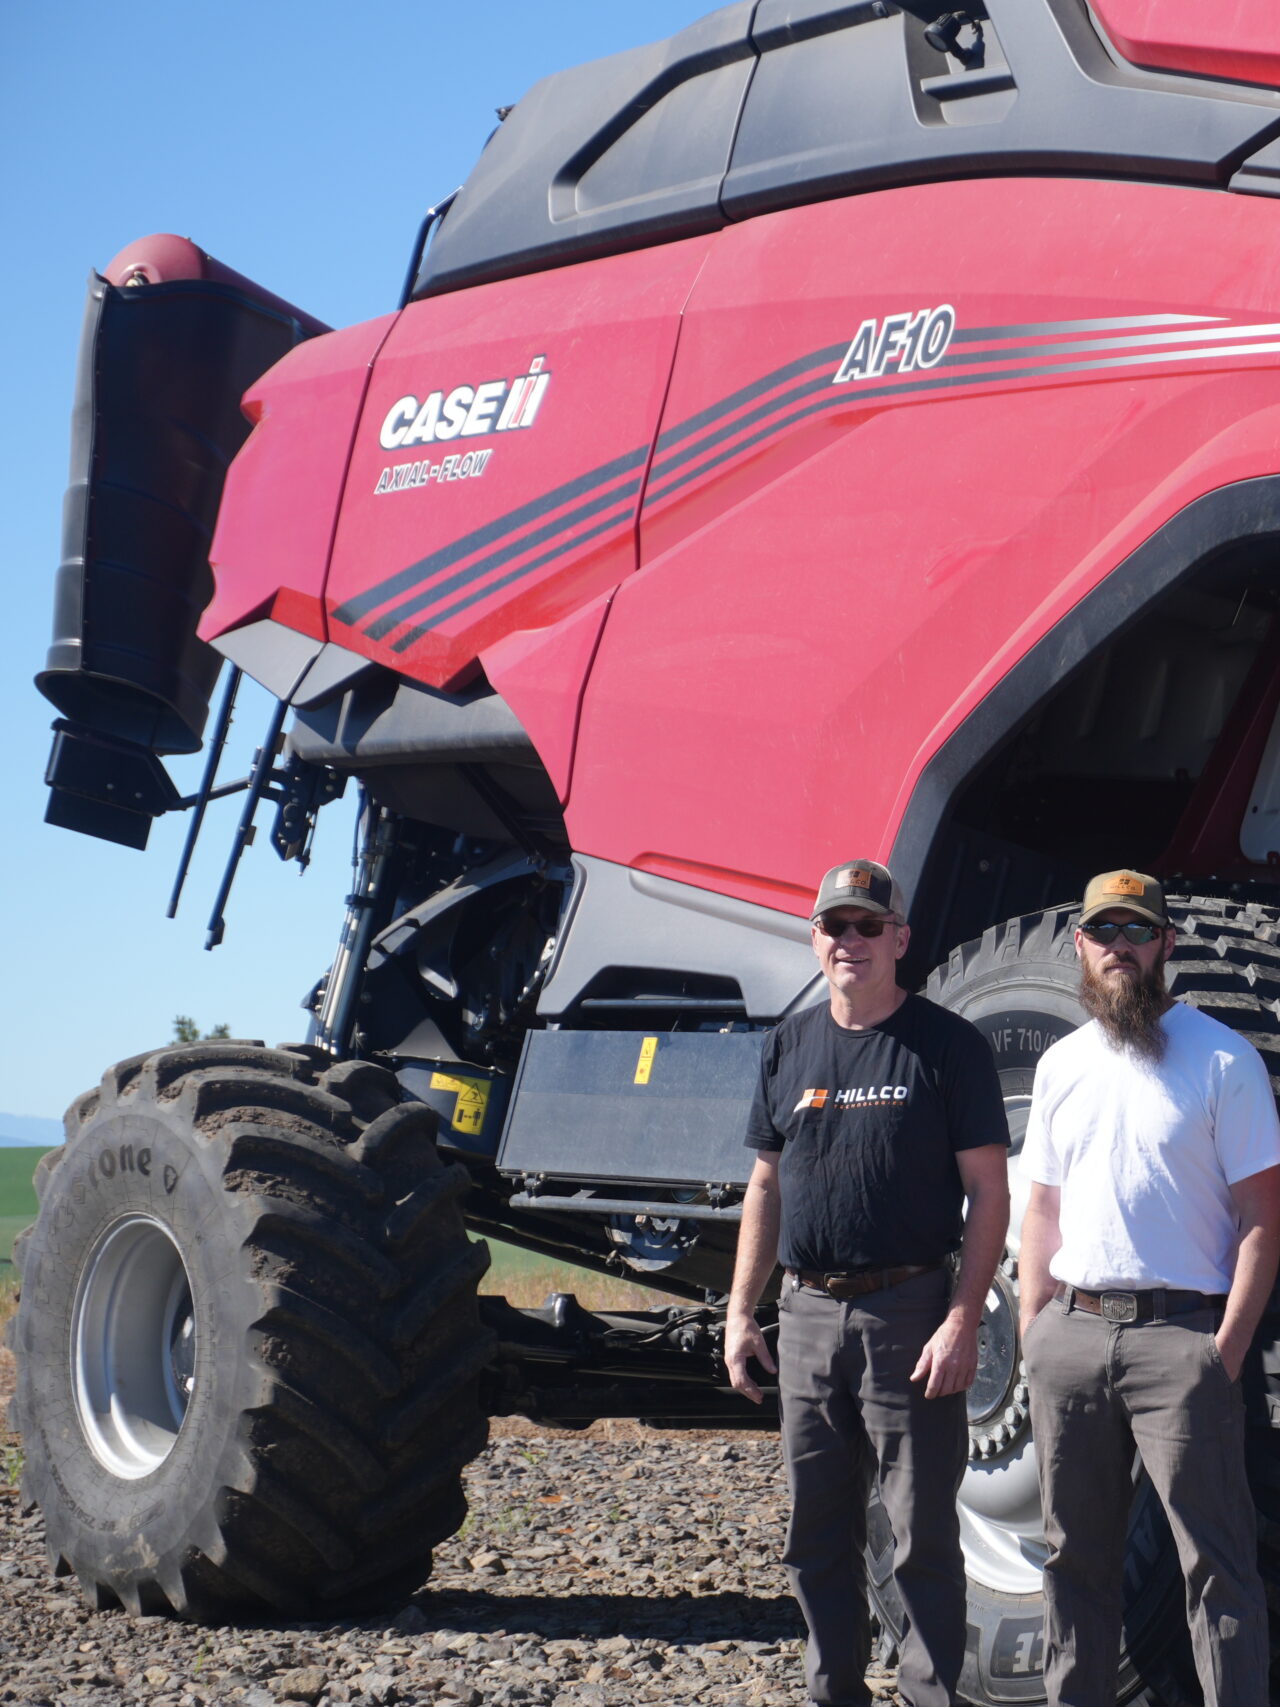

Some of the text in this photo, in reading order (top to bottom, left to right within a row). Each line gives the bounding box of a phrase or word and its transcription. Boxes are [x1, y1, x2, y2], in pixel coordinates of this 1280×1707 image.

[832, 303, 955, 384] AF10
[373, 448, 493, 494] AXIAL-FLOW
[992, 1028, 1012, 1052] VF
[834, 1085, 908, 1104] HILLCO
